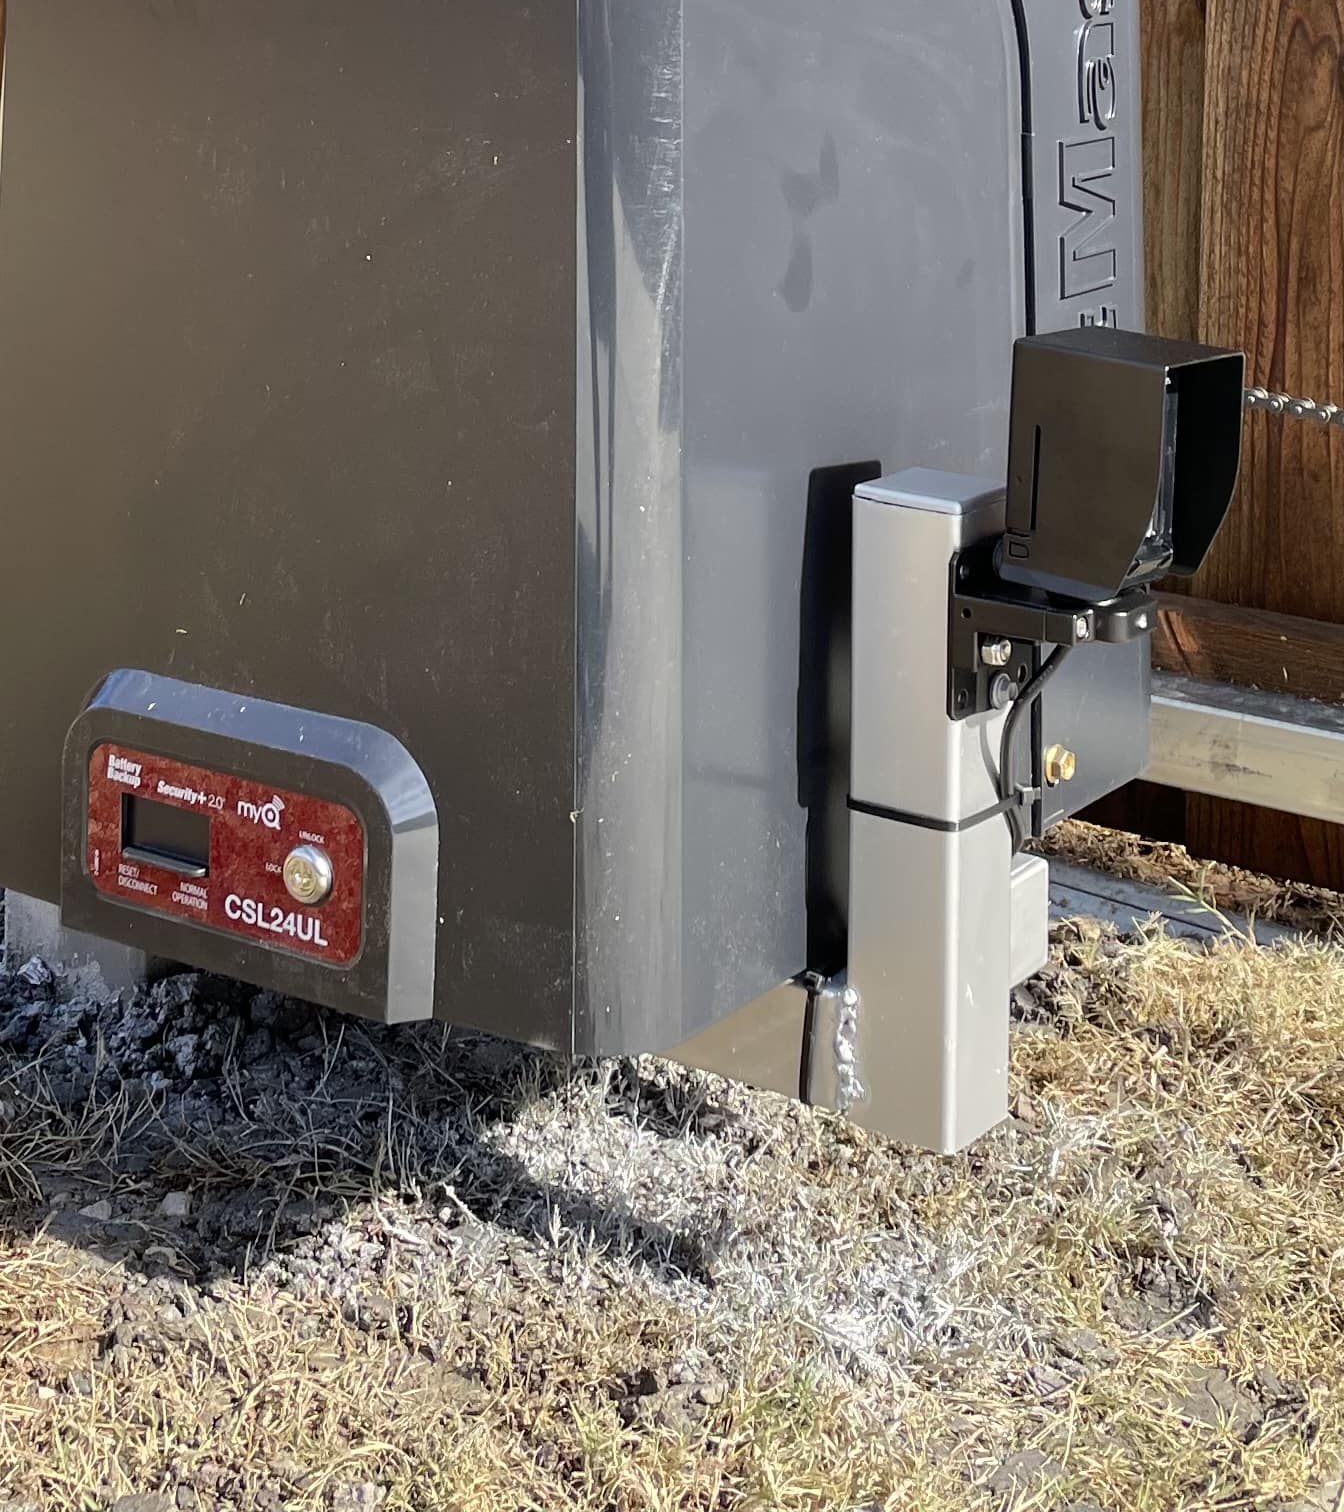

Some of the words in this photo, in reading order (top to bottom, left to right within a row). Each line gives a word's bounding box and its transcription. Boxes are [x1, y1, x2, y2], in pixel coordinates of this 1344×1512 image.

[108, 754, 142, 777] Battery
[237, 797, 283, 830] myQ
[299, 830, 325, 844] UNLOCK
[265, 862, 282, 874] LOCK
[118, 875, 158, 896] DISCONNECT
[179, 881, 208, 899] NORMAL
[171, 891, 208, 911] OPERATION
[224, 893, 329, 947] CSL24UL
